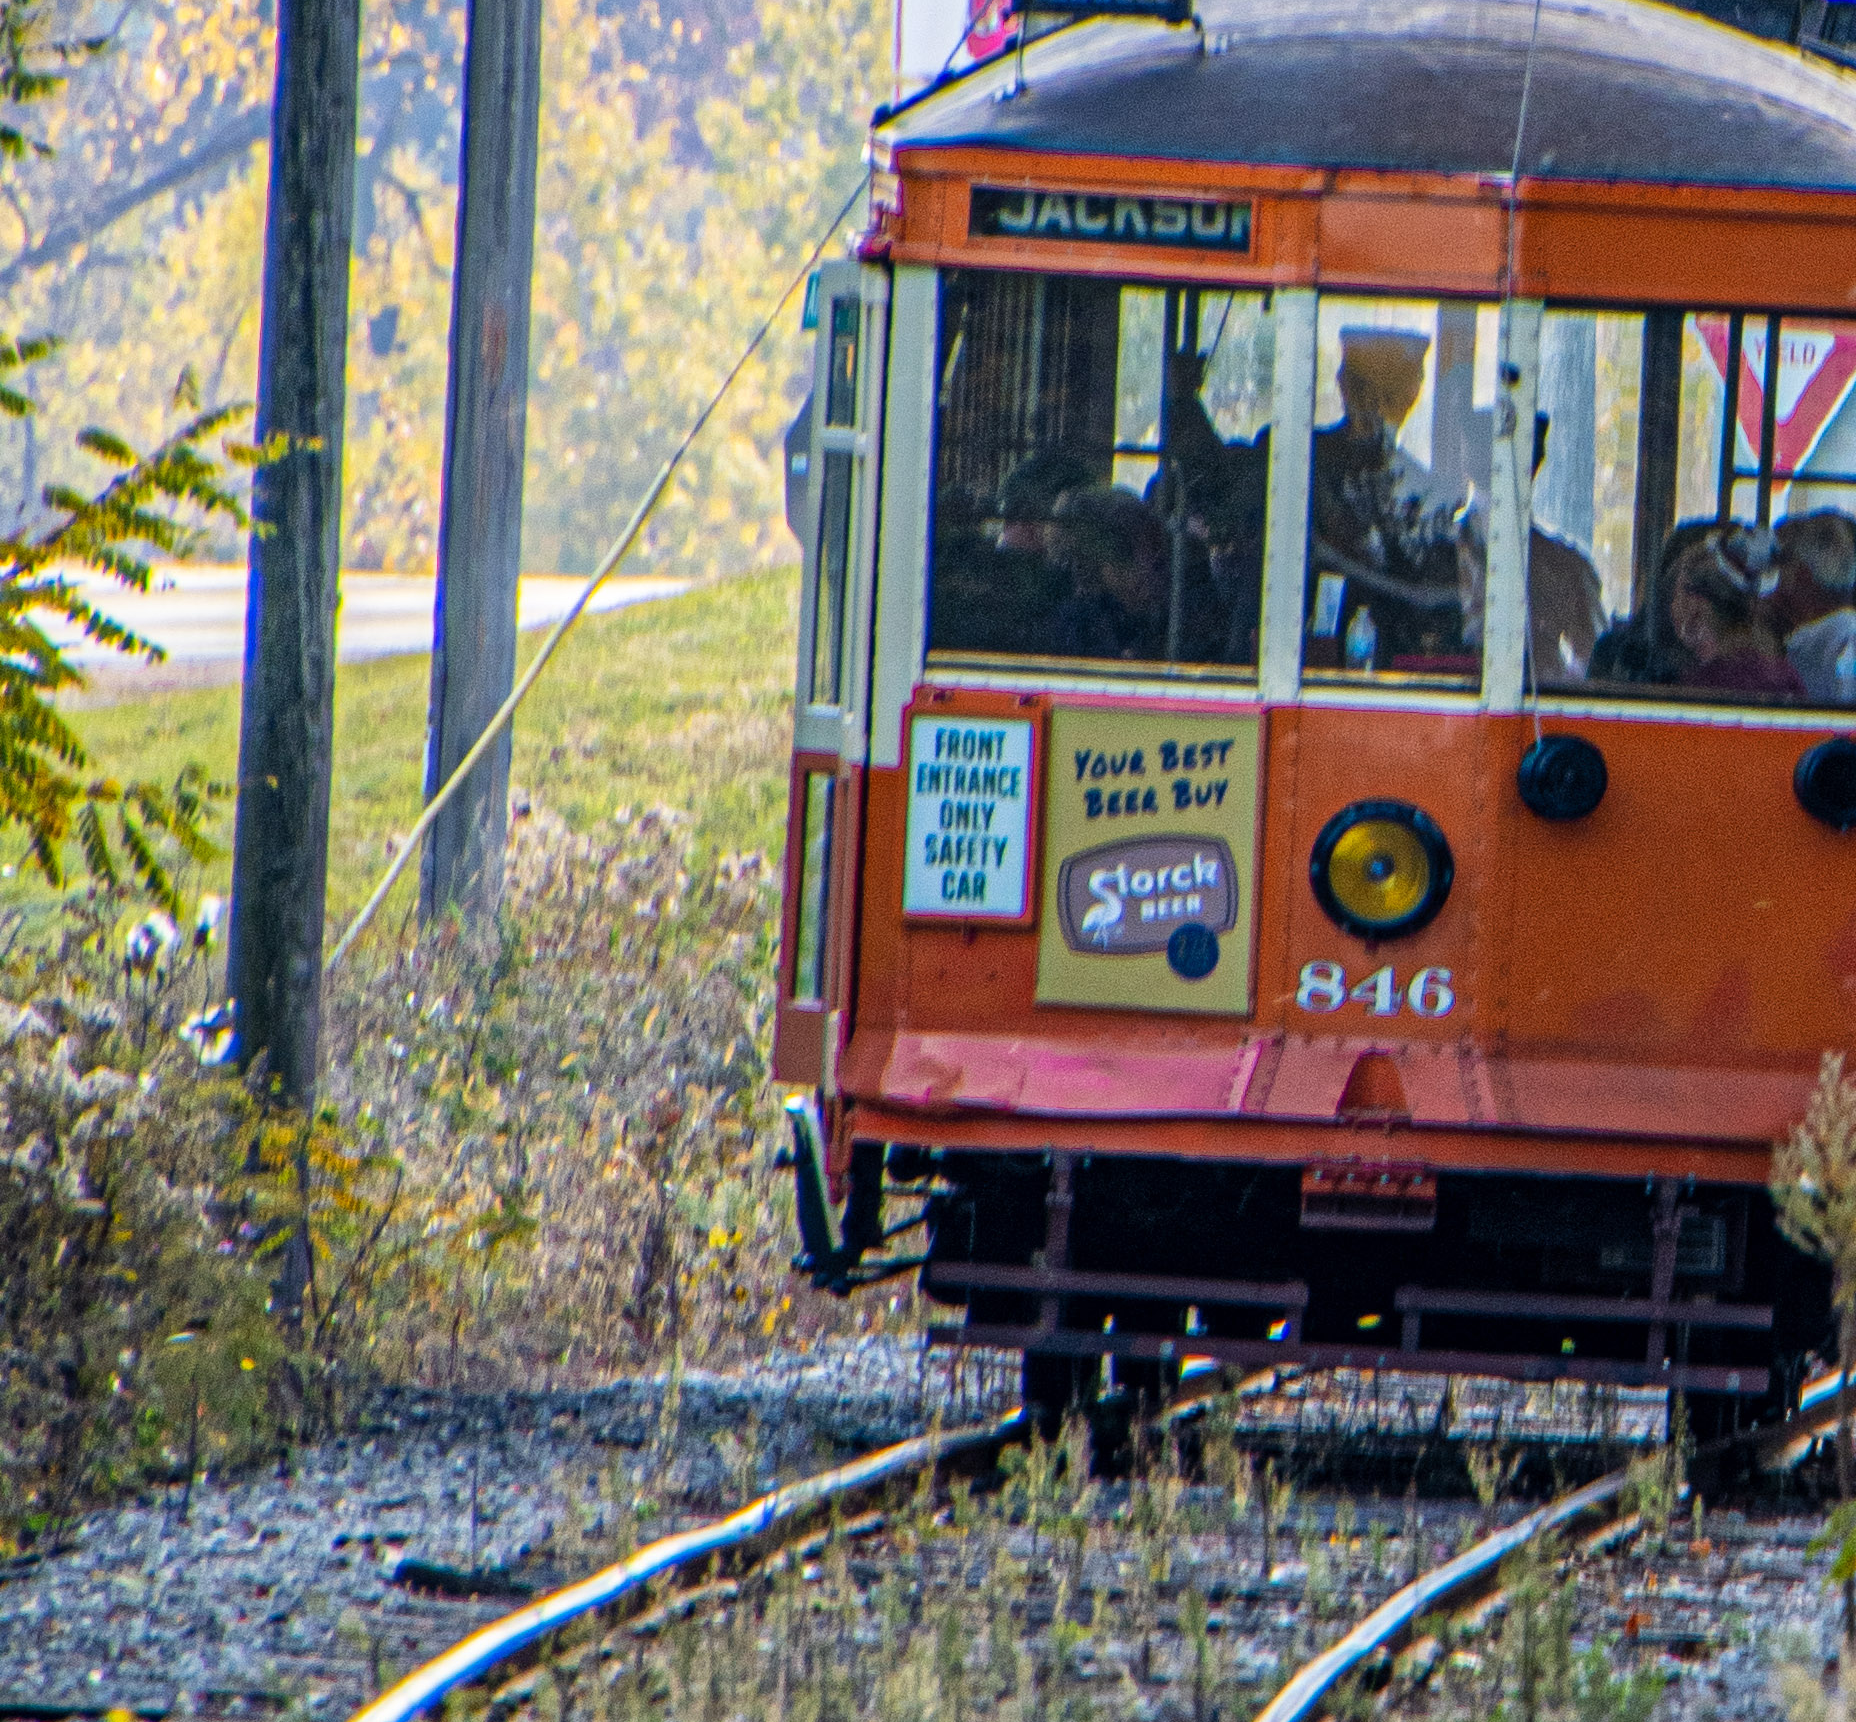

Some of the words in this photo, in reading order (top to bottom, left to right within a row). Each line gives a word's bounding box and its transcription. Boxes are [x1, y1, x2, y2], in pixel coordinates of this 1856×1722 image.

[1754, 339, 1816, 365] YELD
[935, 727, 1007, 761] FRONT
[1074, 746, 1147, 781] YOUR
[1159, 738, 1236, 772] BEST
[916, 763, 1021, 799] ENTRANCE
[1084, 785, 1160, 819] BEER
[1172, 778, 1229, 811] BUY
[940, 799, 996, 832] ONLY
[924, 833, 1009, 870] SAFETY
[942, 870, 988, 903] CAR
[1081, 852, 1221, 934] Storck
[1294, 959, 1457, 1019] 846
